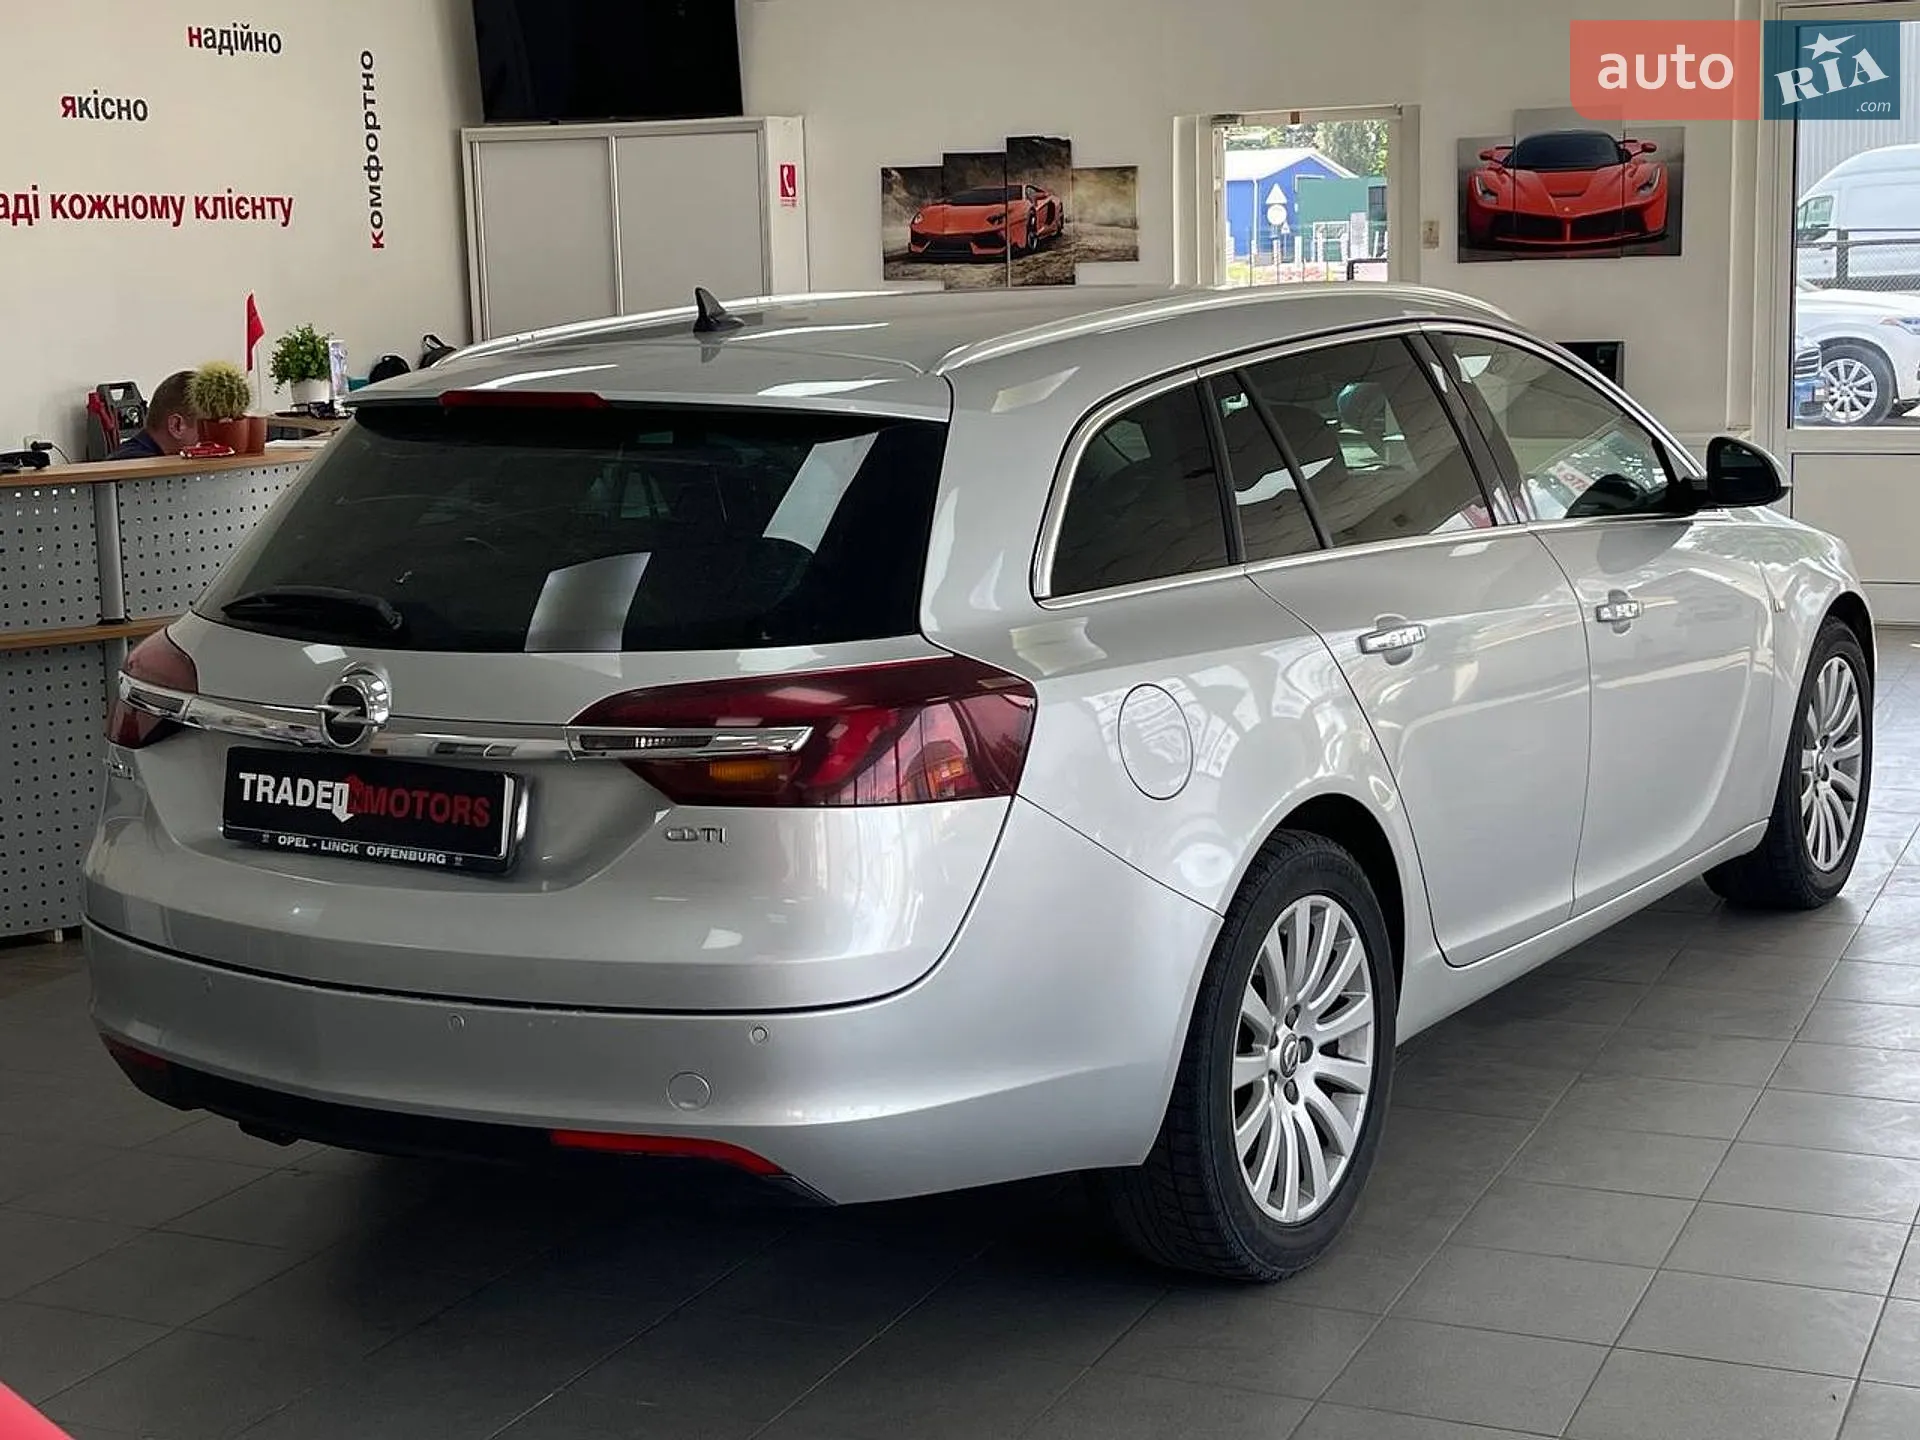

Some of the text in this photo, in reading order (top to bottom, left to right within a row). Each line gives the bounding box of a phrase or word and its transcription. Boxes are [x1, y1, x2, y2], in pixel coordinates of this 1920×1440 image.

[187, 22, 282, 57] надійно
[60, 89, 148, 122] якісно
[360, 50, 385, 249] комфортно
[49, 193, 185, 227] кожному
[195, 188, 294, 227] клієнту
[364, 784, 491, 828] MOTORS
[278, 835, 310, 848] OPEL
[321, 840, 359, 854] LINCK
[366, 845, 447, 865] OFFENBURG
[665, 827, 726, 843] CDTI
